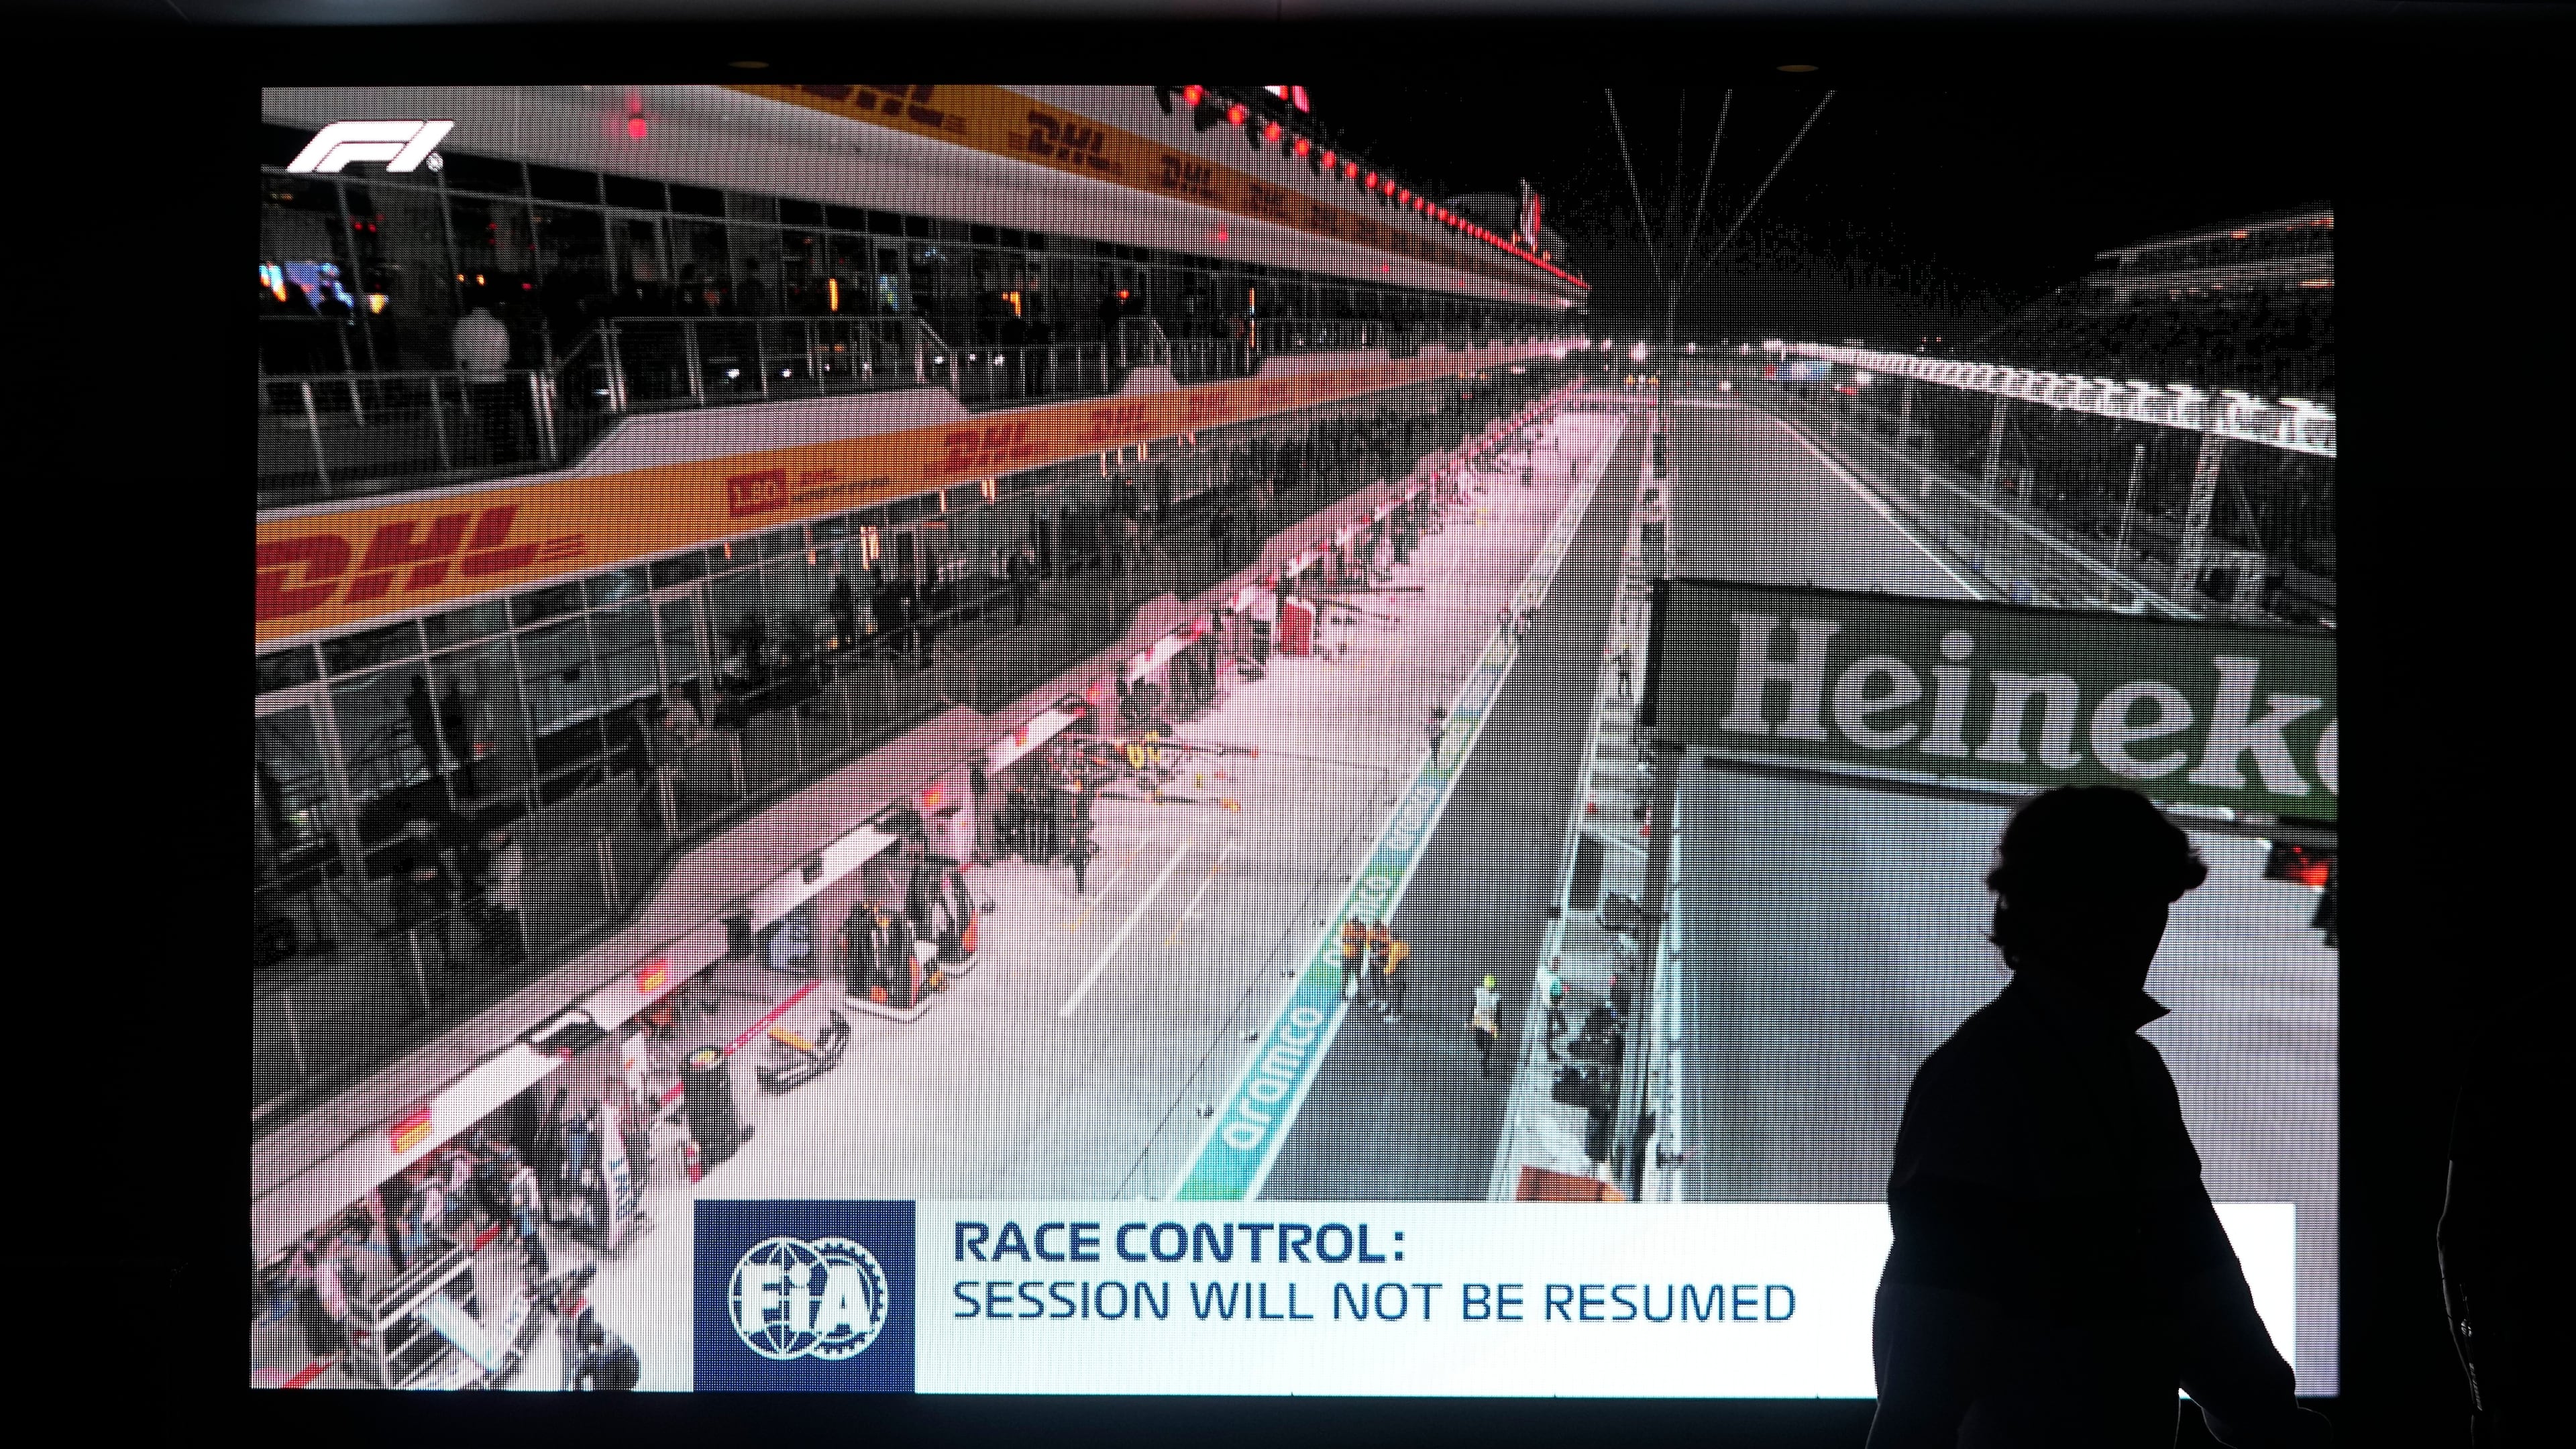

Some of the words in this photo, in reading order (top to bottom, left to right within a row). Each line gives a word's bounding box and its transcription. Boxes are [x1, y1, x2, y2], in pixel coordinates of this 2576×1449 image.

[286, 121, 454, 172] F1
[1027, 111, 1112, 171] DHL
[944, 421, 1034, 474] DHL
[1091, 404, 1151, 443] DHL
[256, 504, 539, 621] DHL
[1719, 613, 2337, 796] Heinek
[1222, 1006, 1324, 1151] aramco
[955, 1221, 1100, 1263] RACE
[1117, 1221, 1405, 1264] CONTROL:
[954, 1281, 1169, 1320] SESSION
[1191, 1282, 1313, 1322] WILL
[1333, 1282, 1443, 1322] NOT
[1462, 1282, 1524, 1322] BE
[1546, 1282, 1796, 1323] RESUMED
